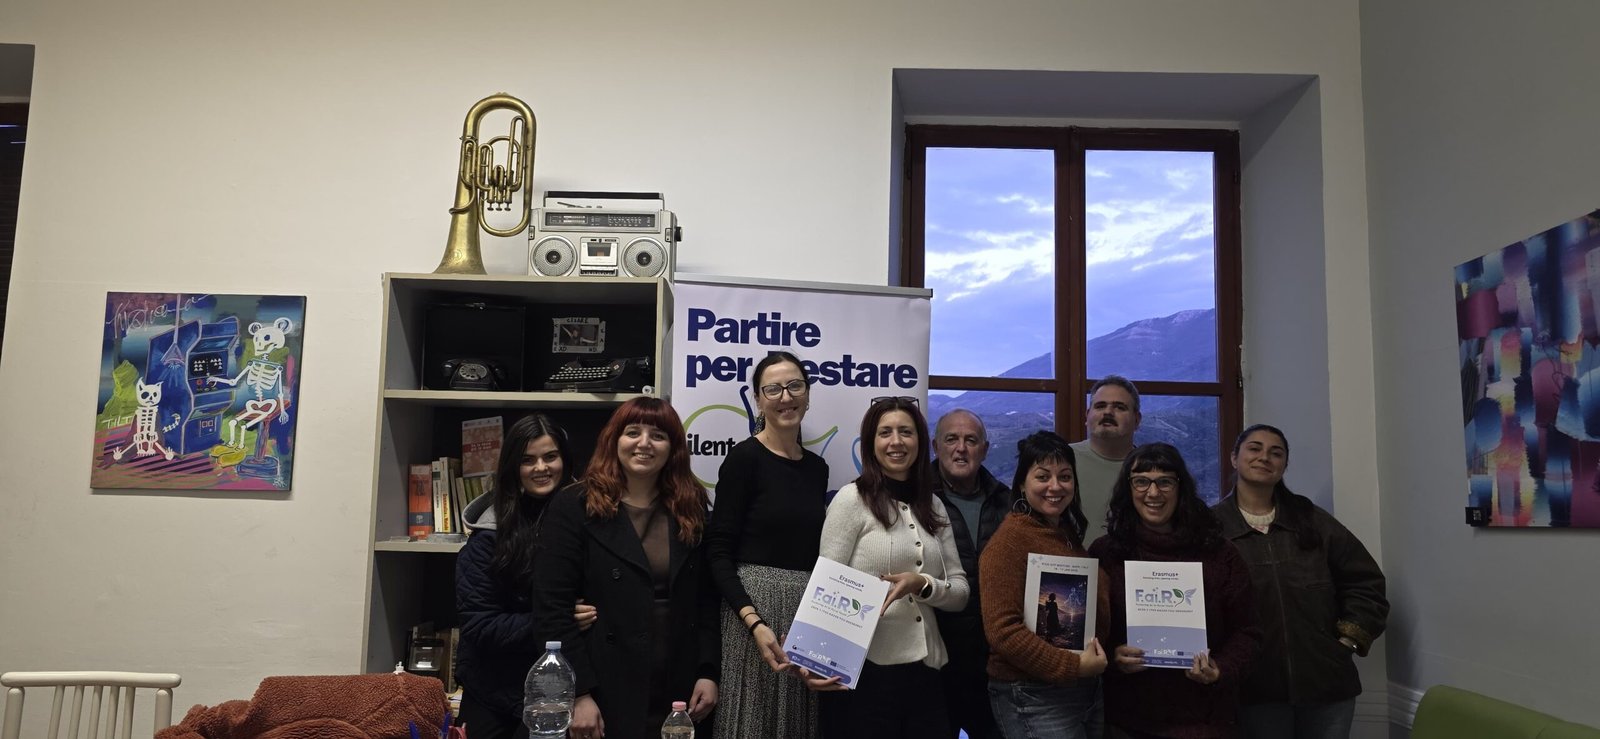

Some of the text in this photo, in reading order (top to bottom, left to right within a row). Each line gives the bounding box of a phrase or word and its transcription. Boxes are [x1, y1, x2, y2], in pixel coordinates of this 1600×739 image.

[687, 308, 821, 348] Partire
[686, 351, 918, 389] per estare
